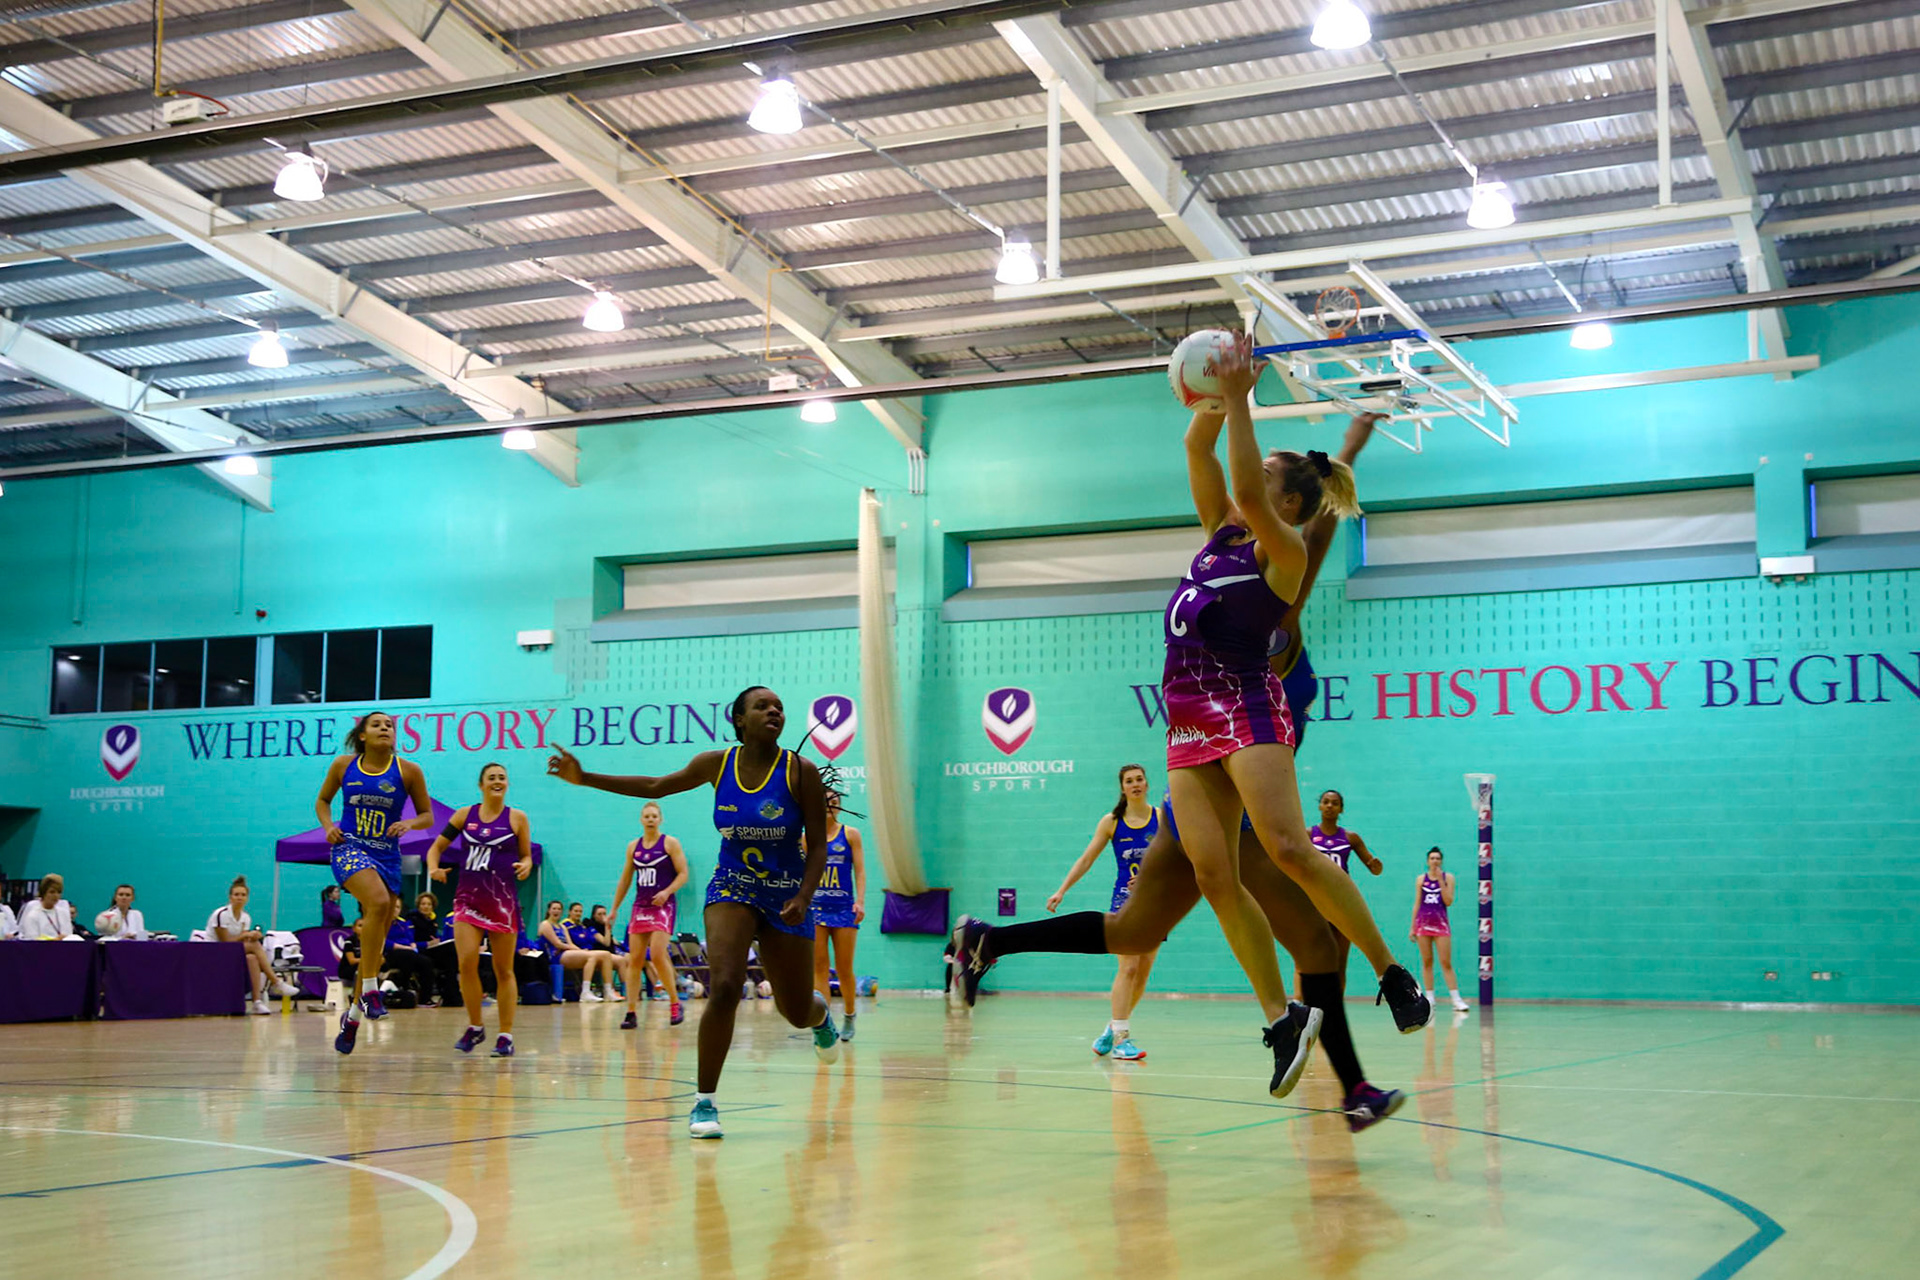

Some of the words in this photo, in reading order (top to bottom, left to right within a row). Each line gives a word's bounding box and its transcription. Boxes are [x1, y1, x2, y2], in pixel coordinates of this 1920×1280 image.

[1169, 588, 1198, 637] C
[1372, 660, 1679, 720] HISTORY
[181, 717, 337, 760] WHERE
[352, 708, 557, 754] ISTORY
[945, 760, 1074, 776] LOUGHBOROUGH
[972, 779, 1047, 792] SPORT
[355, 808, 386, 837] WD
[735, 826, 787, 838] SPORTING
[465, 845, 492, 871] WA
[637, 868, 657, 887] WD
